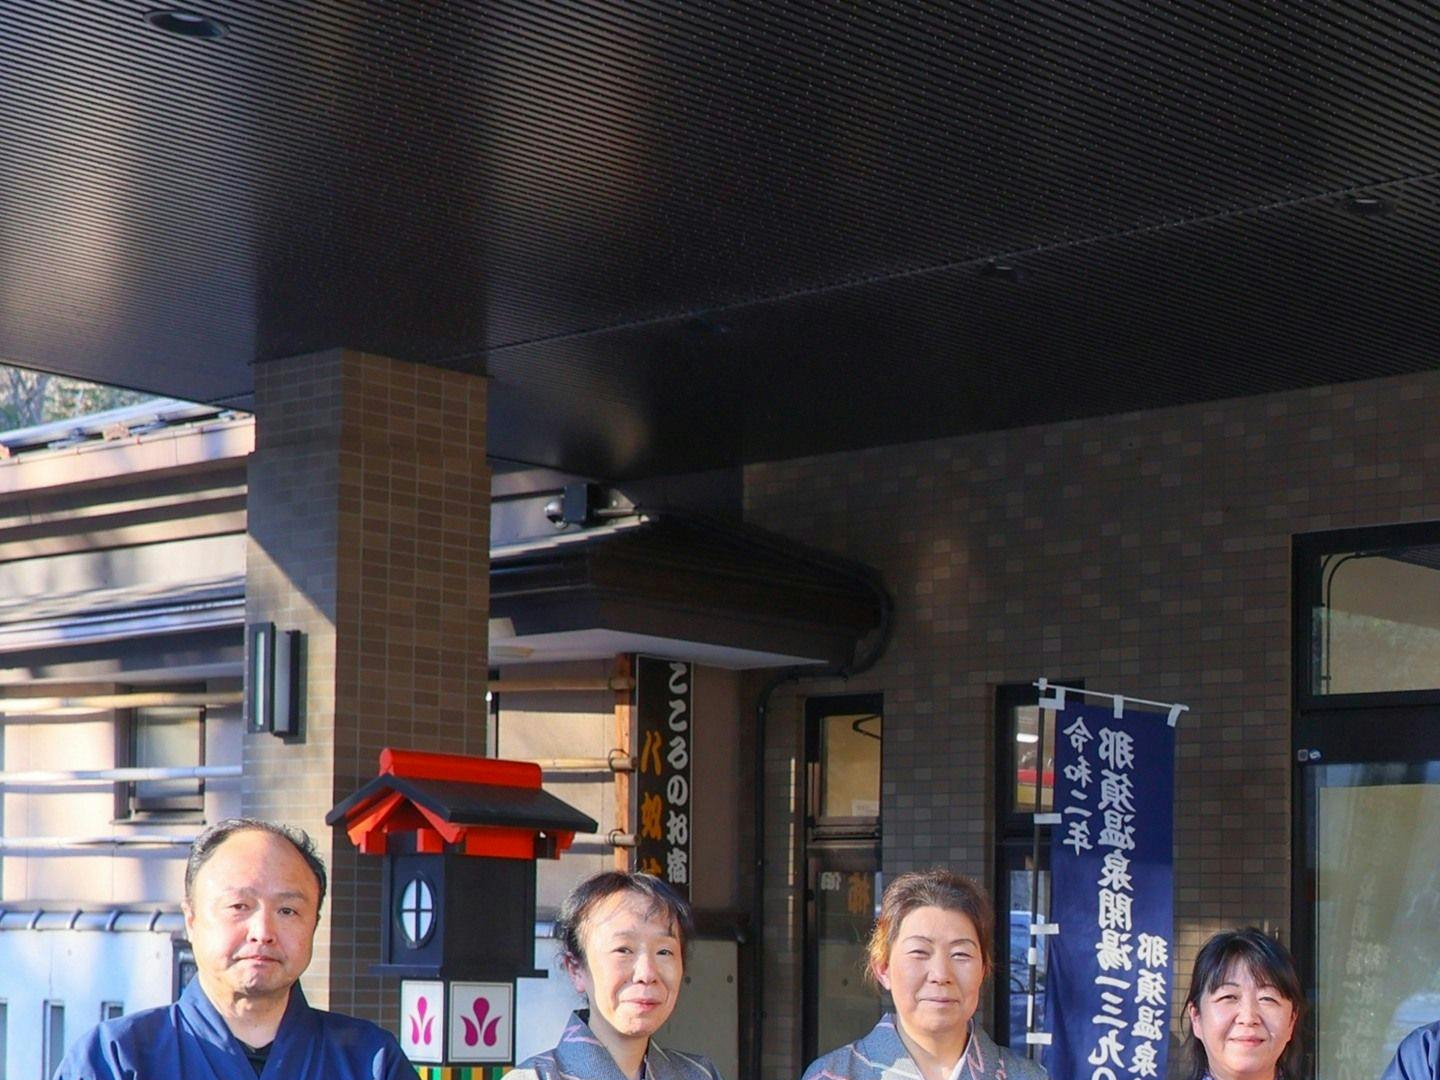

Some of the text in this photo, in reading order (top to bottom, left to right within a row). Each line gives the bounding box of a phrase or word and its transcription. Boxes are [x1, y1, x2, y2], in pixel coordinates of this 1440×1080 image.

[666, 661, 690, 885] こころのお宿
